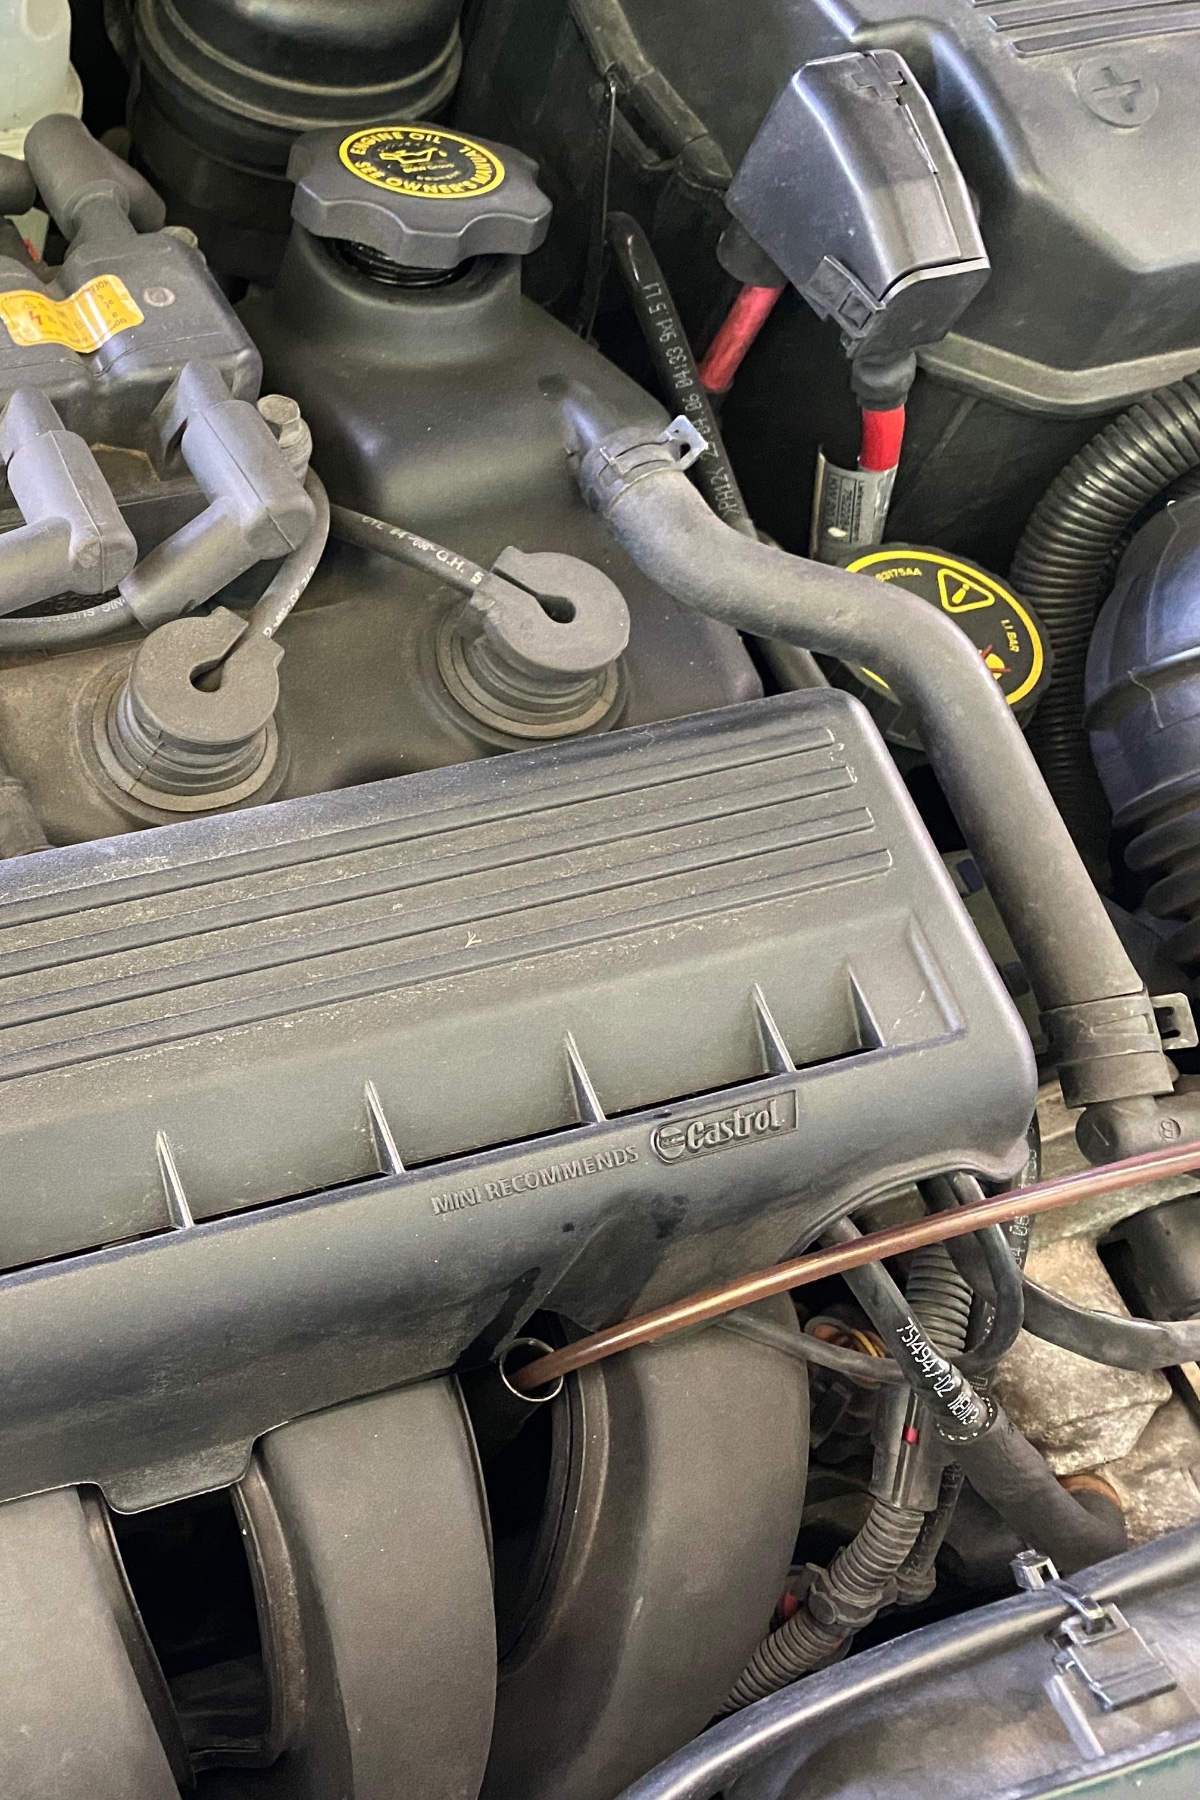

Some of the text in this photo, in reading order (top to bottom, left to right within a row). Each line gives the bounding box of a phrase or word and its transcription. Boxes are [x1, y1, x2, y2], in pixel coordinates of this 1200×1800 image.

[350, 131, 404, 155] ENGINE
[409, 132, 442, 144] OIL
[355, 161, 386, 179] SEE
[385, 176, 478, 194] OWNER'S
[458, 145, 493, 185] MANUAL
[430, 1099, 782, 1216] MINI RECOMMENDS Castrol
